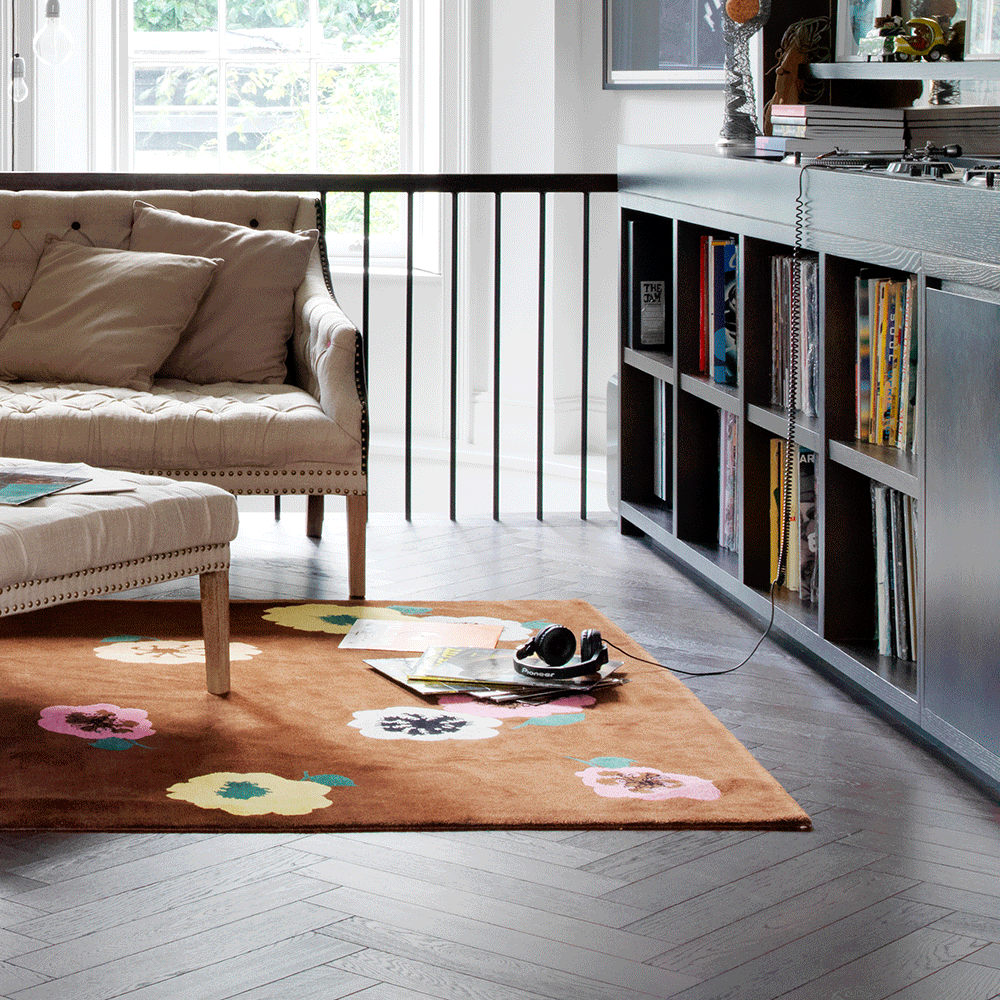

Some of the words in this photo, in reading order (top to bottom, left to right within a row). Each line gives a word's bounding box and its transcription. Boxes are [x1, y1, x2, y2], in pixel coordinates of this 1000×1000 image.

[643, 283, 662, 293] THE
[643, 292, 662, 303] JAM
[521, 667, 556, 678] Pioneer
